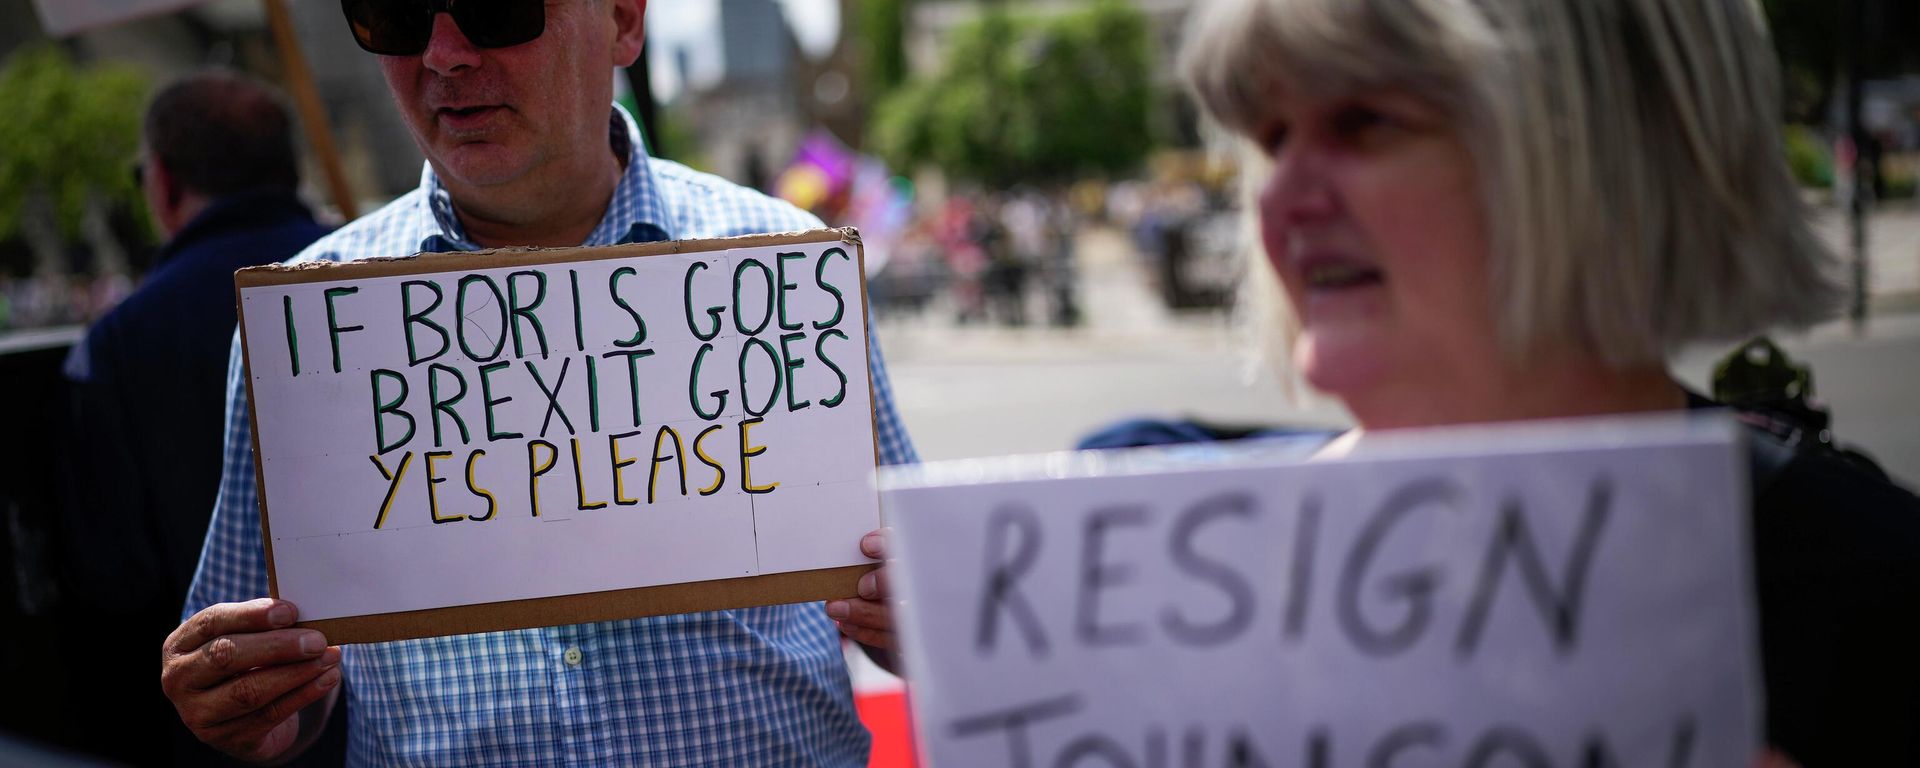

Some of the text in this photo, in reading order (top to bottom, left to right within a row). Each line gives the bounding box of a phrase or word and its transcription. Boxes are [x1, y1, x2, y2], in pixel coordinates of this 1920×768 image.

[283, 247, 851, 376] IF BORIS GOES
[370, 328, 849, 455] BREXIT GOES
[370, 417, 781, 529] YES PLEASE
[973, 471, 1616, 662] RESIGN
